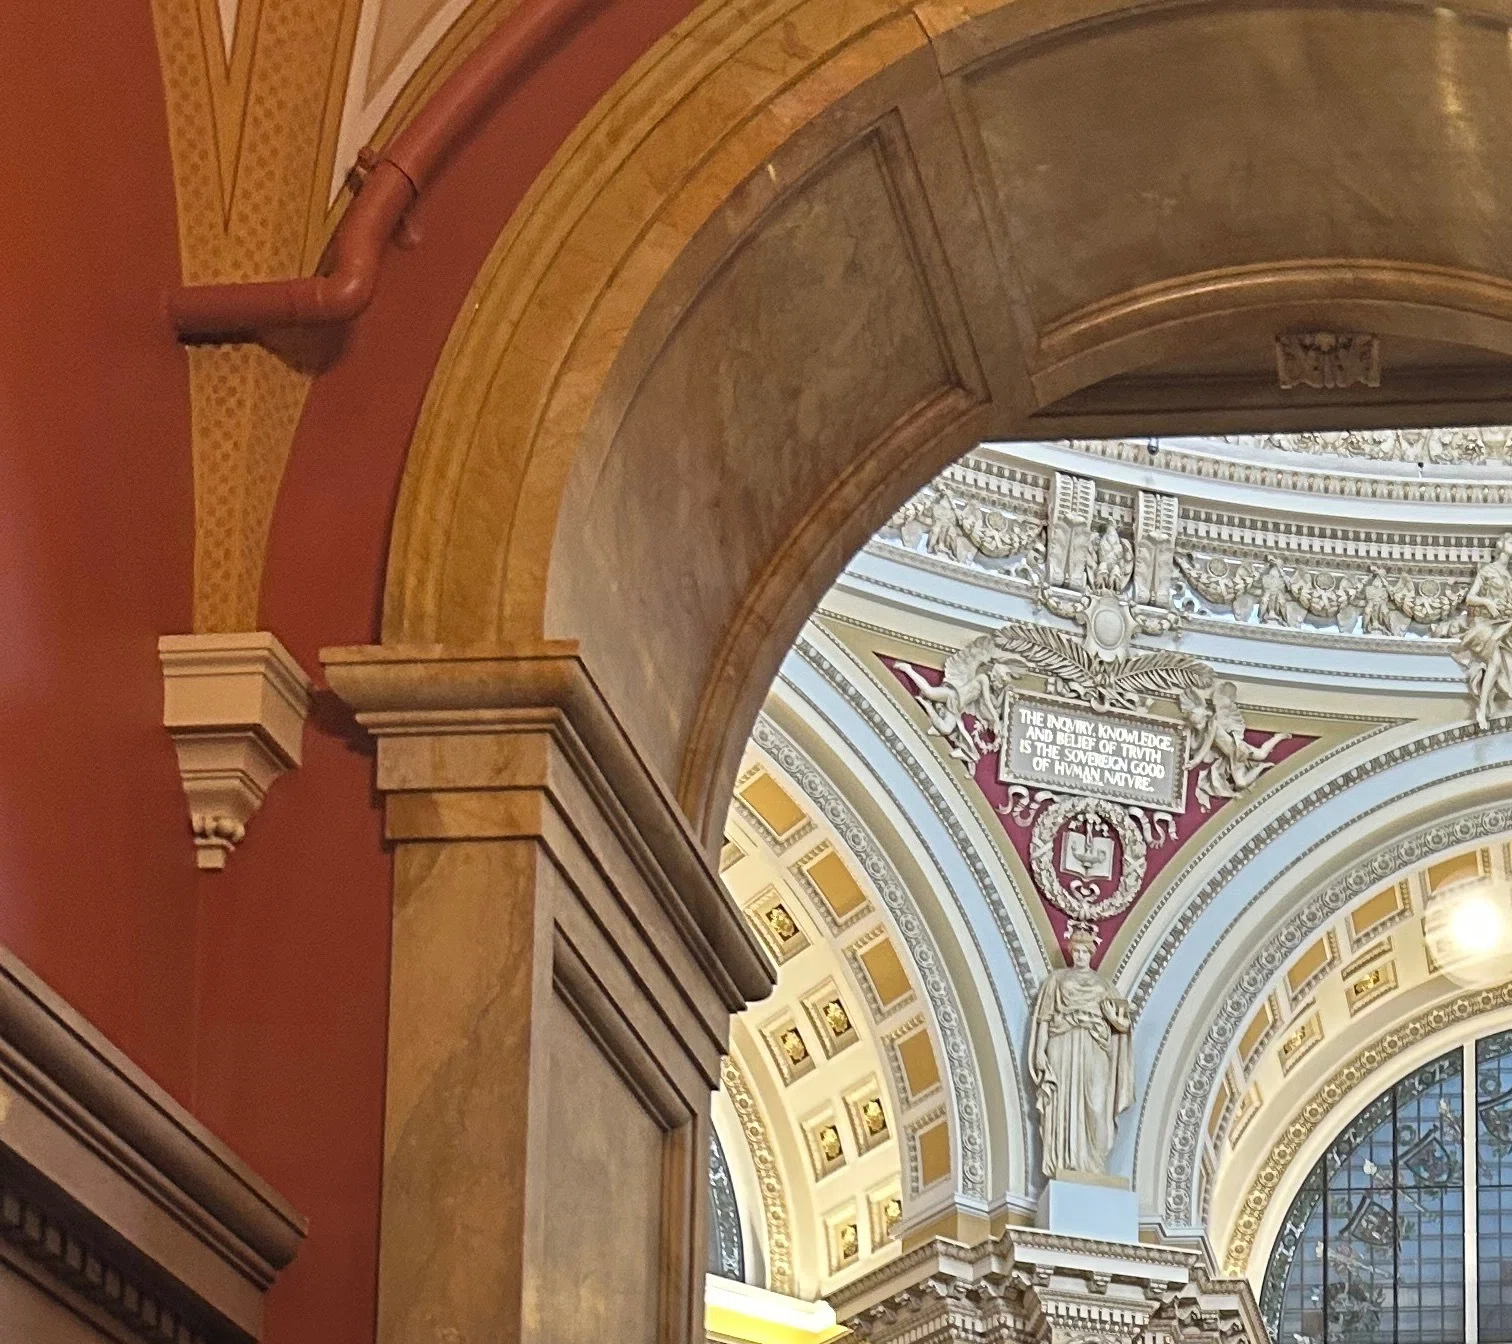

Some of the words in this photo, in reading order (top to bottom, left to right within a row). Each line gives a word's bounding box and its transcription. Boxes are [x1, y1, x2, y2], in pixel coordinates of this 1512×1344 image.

[1019, 709, 1044, 727] THE
[1026, 726, 1053, 742] AND
[1056, 731, 1096, 750] BELIEF
[1099, 740, 1117, 754] OF
[1020, 739, 1031, 754] IS
[1034, 742, 1061, 759] THE
[1064, 748, 1128, 772] SOVEREIGN
[1130, 760, 1165, 779] GOOD
[1033, 757, 1051, 772] OF
